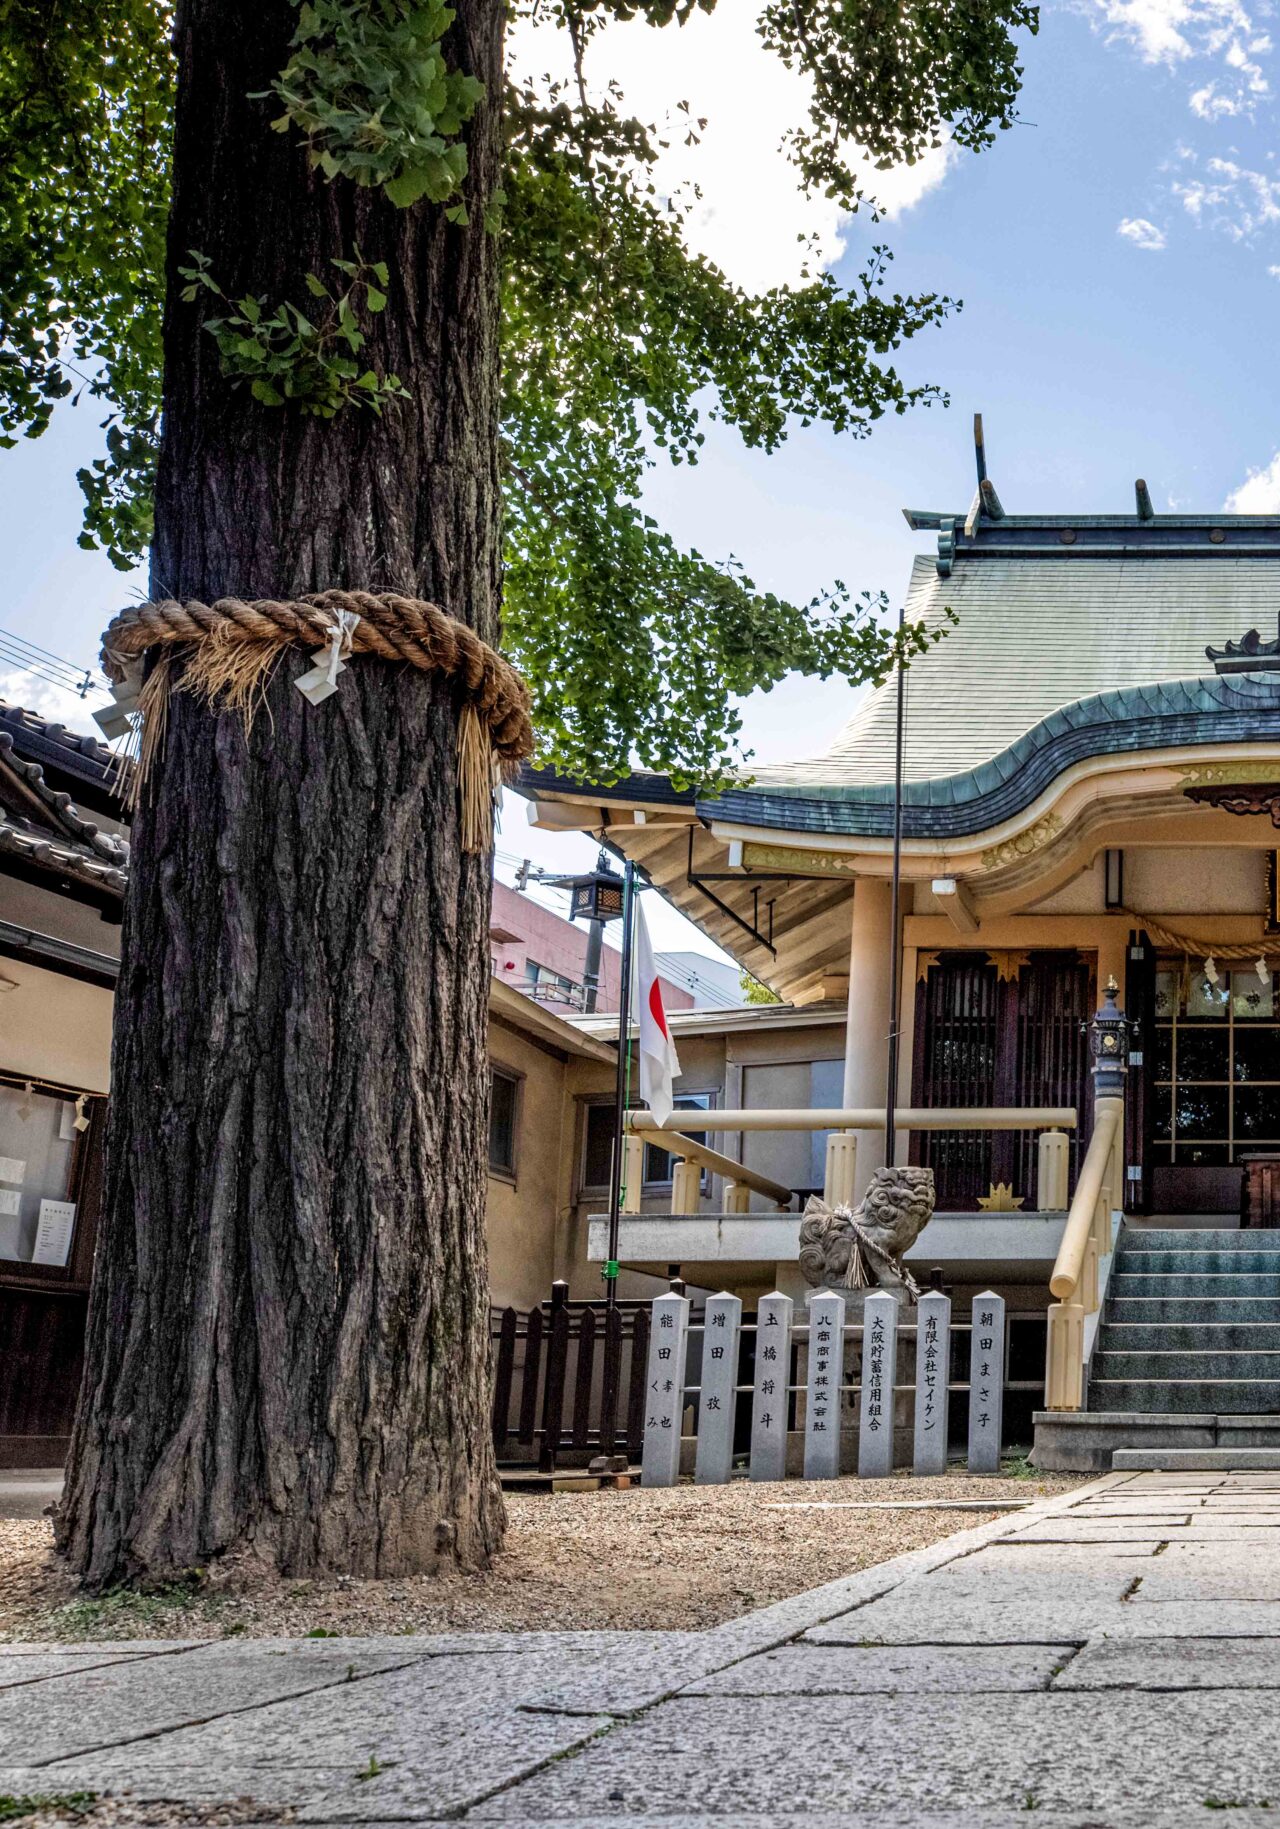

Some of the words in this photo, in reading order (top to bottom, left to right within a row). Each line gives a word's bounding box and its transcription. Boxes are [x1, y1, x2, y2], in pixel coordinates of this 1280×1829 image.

[658, 1313, 673, 1360] 能田
[868, 1316, 885, 1432] 大阪貯蓄信用組合
[923, 1315, 939, 1431] 有限会社セイケン
[977, 1312, 994, 1427] 朝田まさ子
[646, 1380, 658, 1428] くみ
[660, 1379, 674, 1428] 孝也
